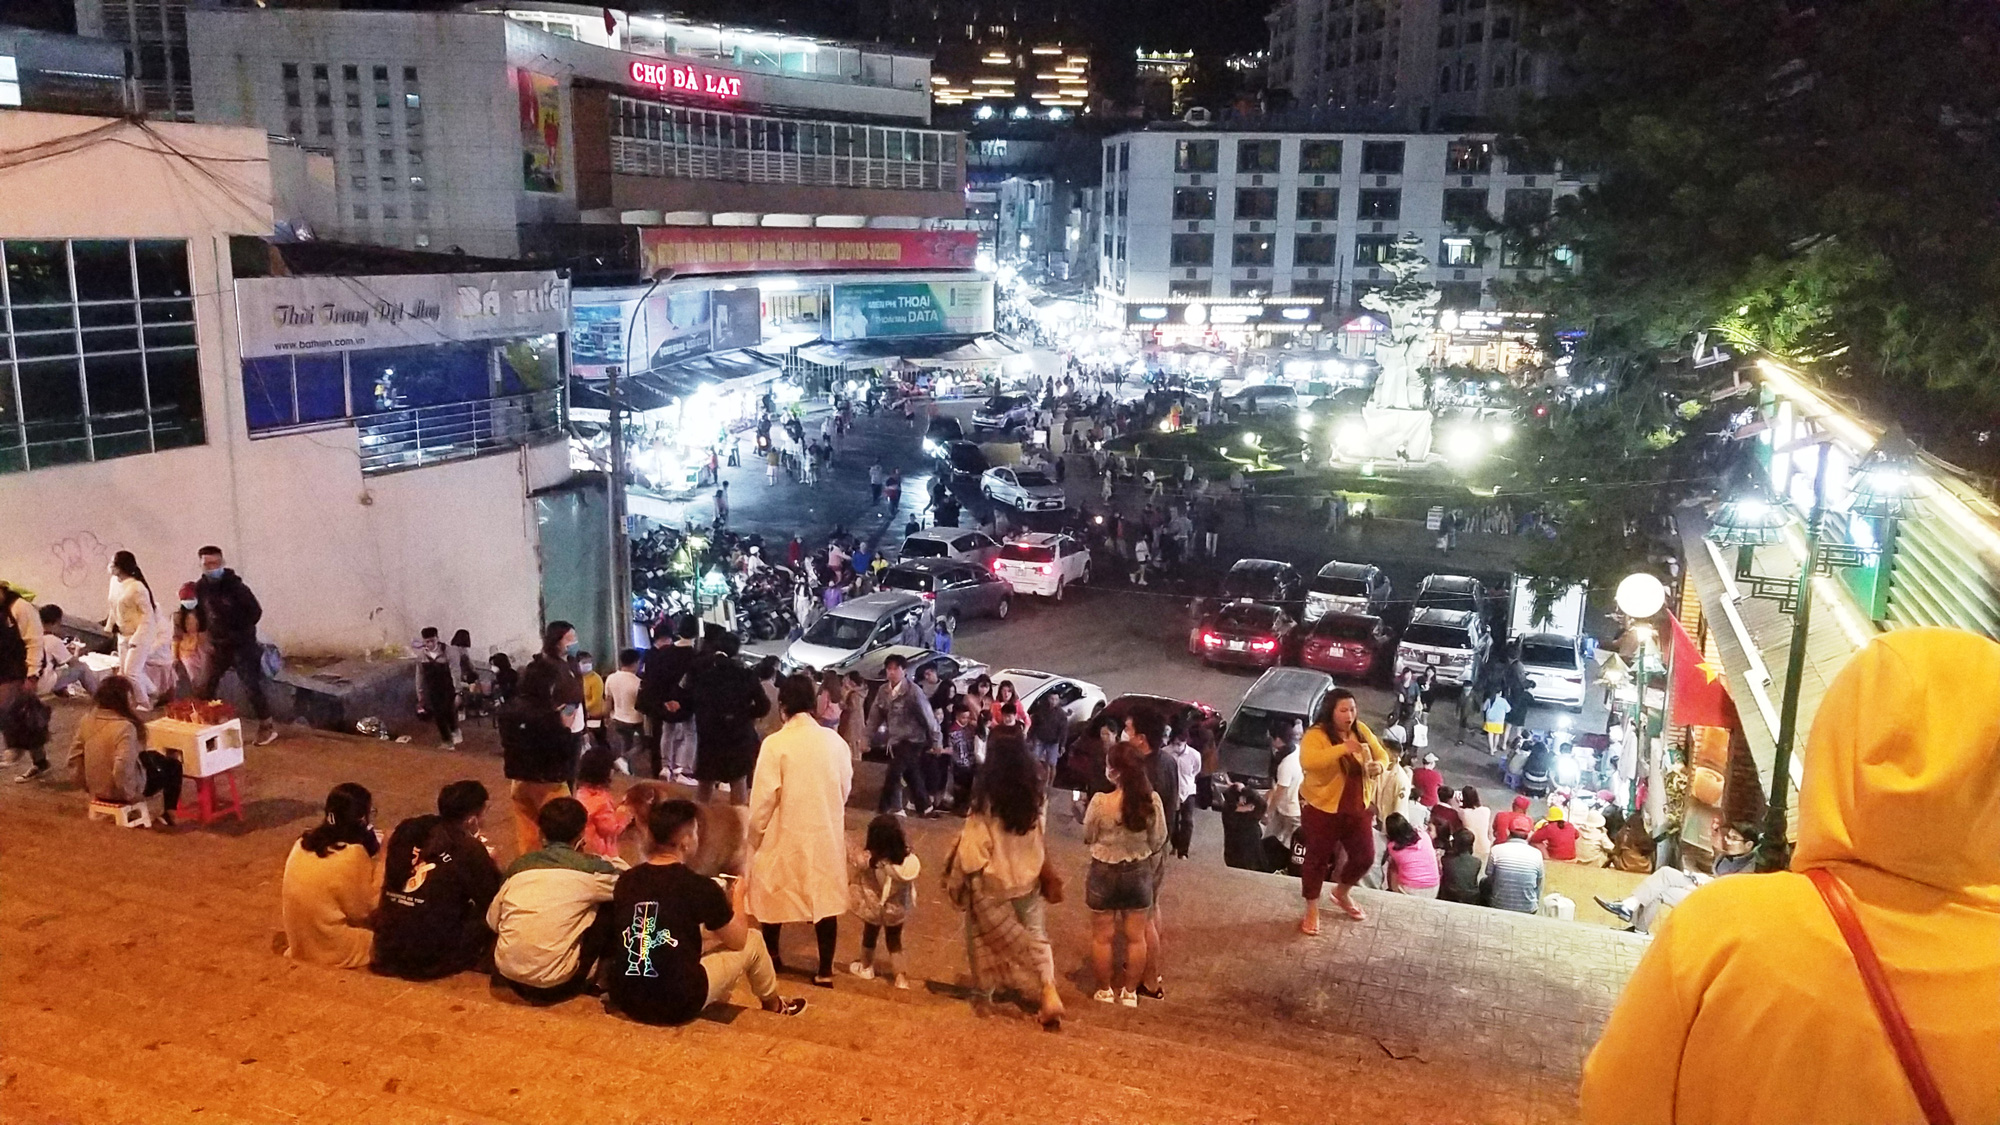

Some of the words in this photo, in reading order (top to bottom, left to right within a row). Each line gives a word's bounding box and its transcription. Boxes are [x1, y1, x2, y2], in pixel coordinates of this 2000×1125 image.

[632, 62, 667, 91] CHỢ
[673, 65, 699, 91] ĐÀ
[704, 74, 741, 99] LẠT
[457, 279, 500, 317] BÁ
[897, 295, 930, 309] THOẠI
[908, 310, 939, 323] DATA
